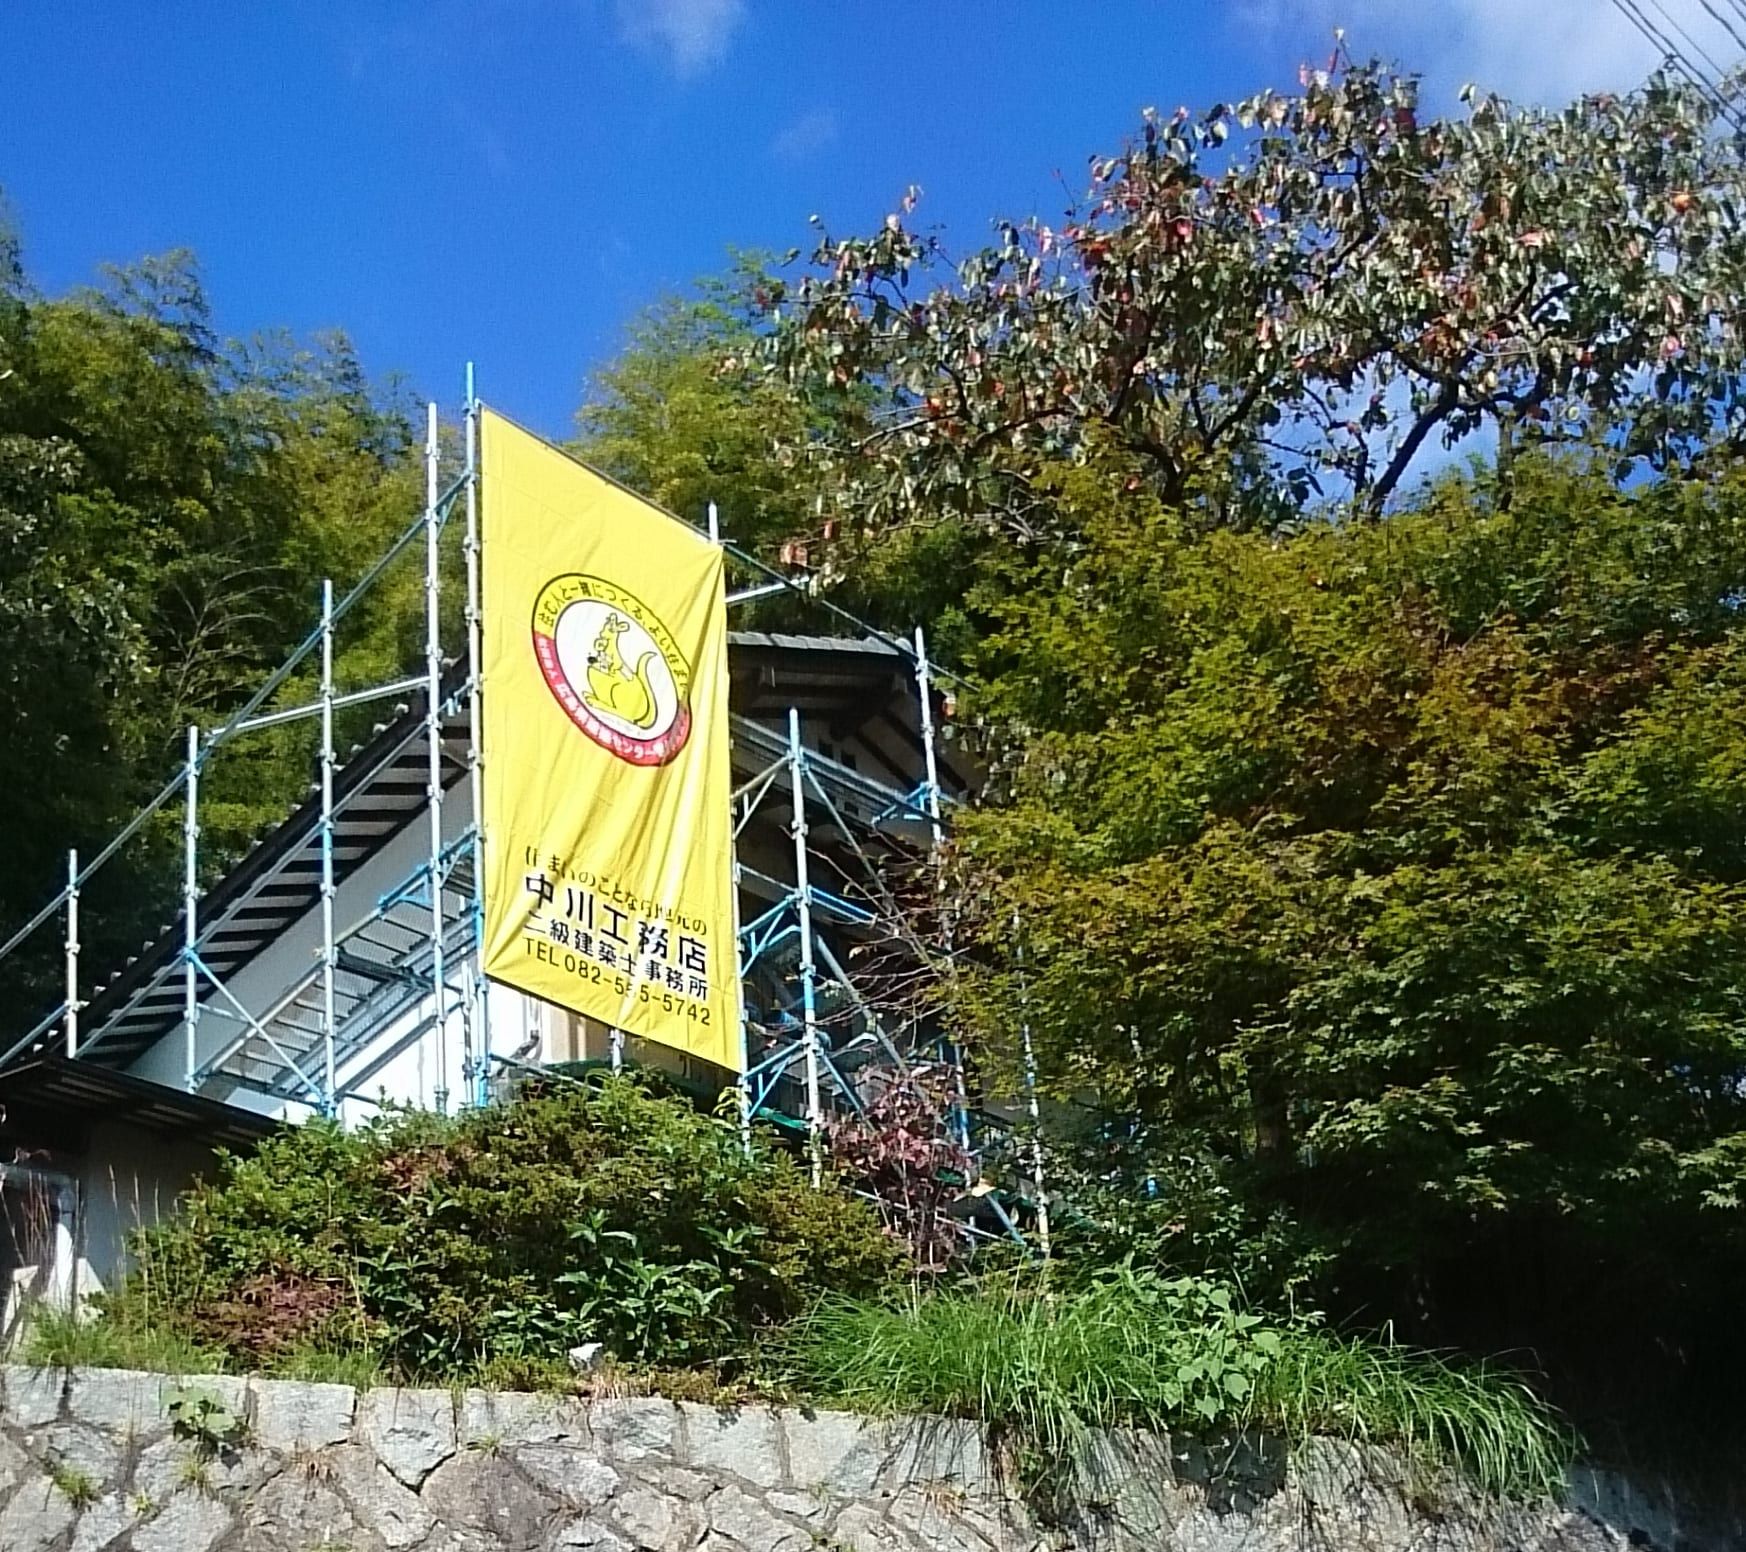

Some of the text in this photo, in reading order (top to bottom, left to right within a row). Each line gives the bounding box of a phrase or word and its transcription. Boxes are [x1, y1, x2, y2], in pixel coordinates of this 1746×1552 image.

[523, 909, 708, 1001] 二級建築士事務所
[525, 873, 707, 975] 中川工務店
